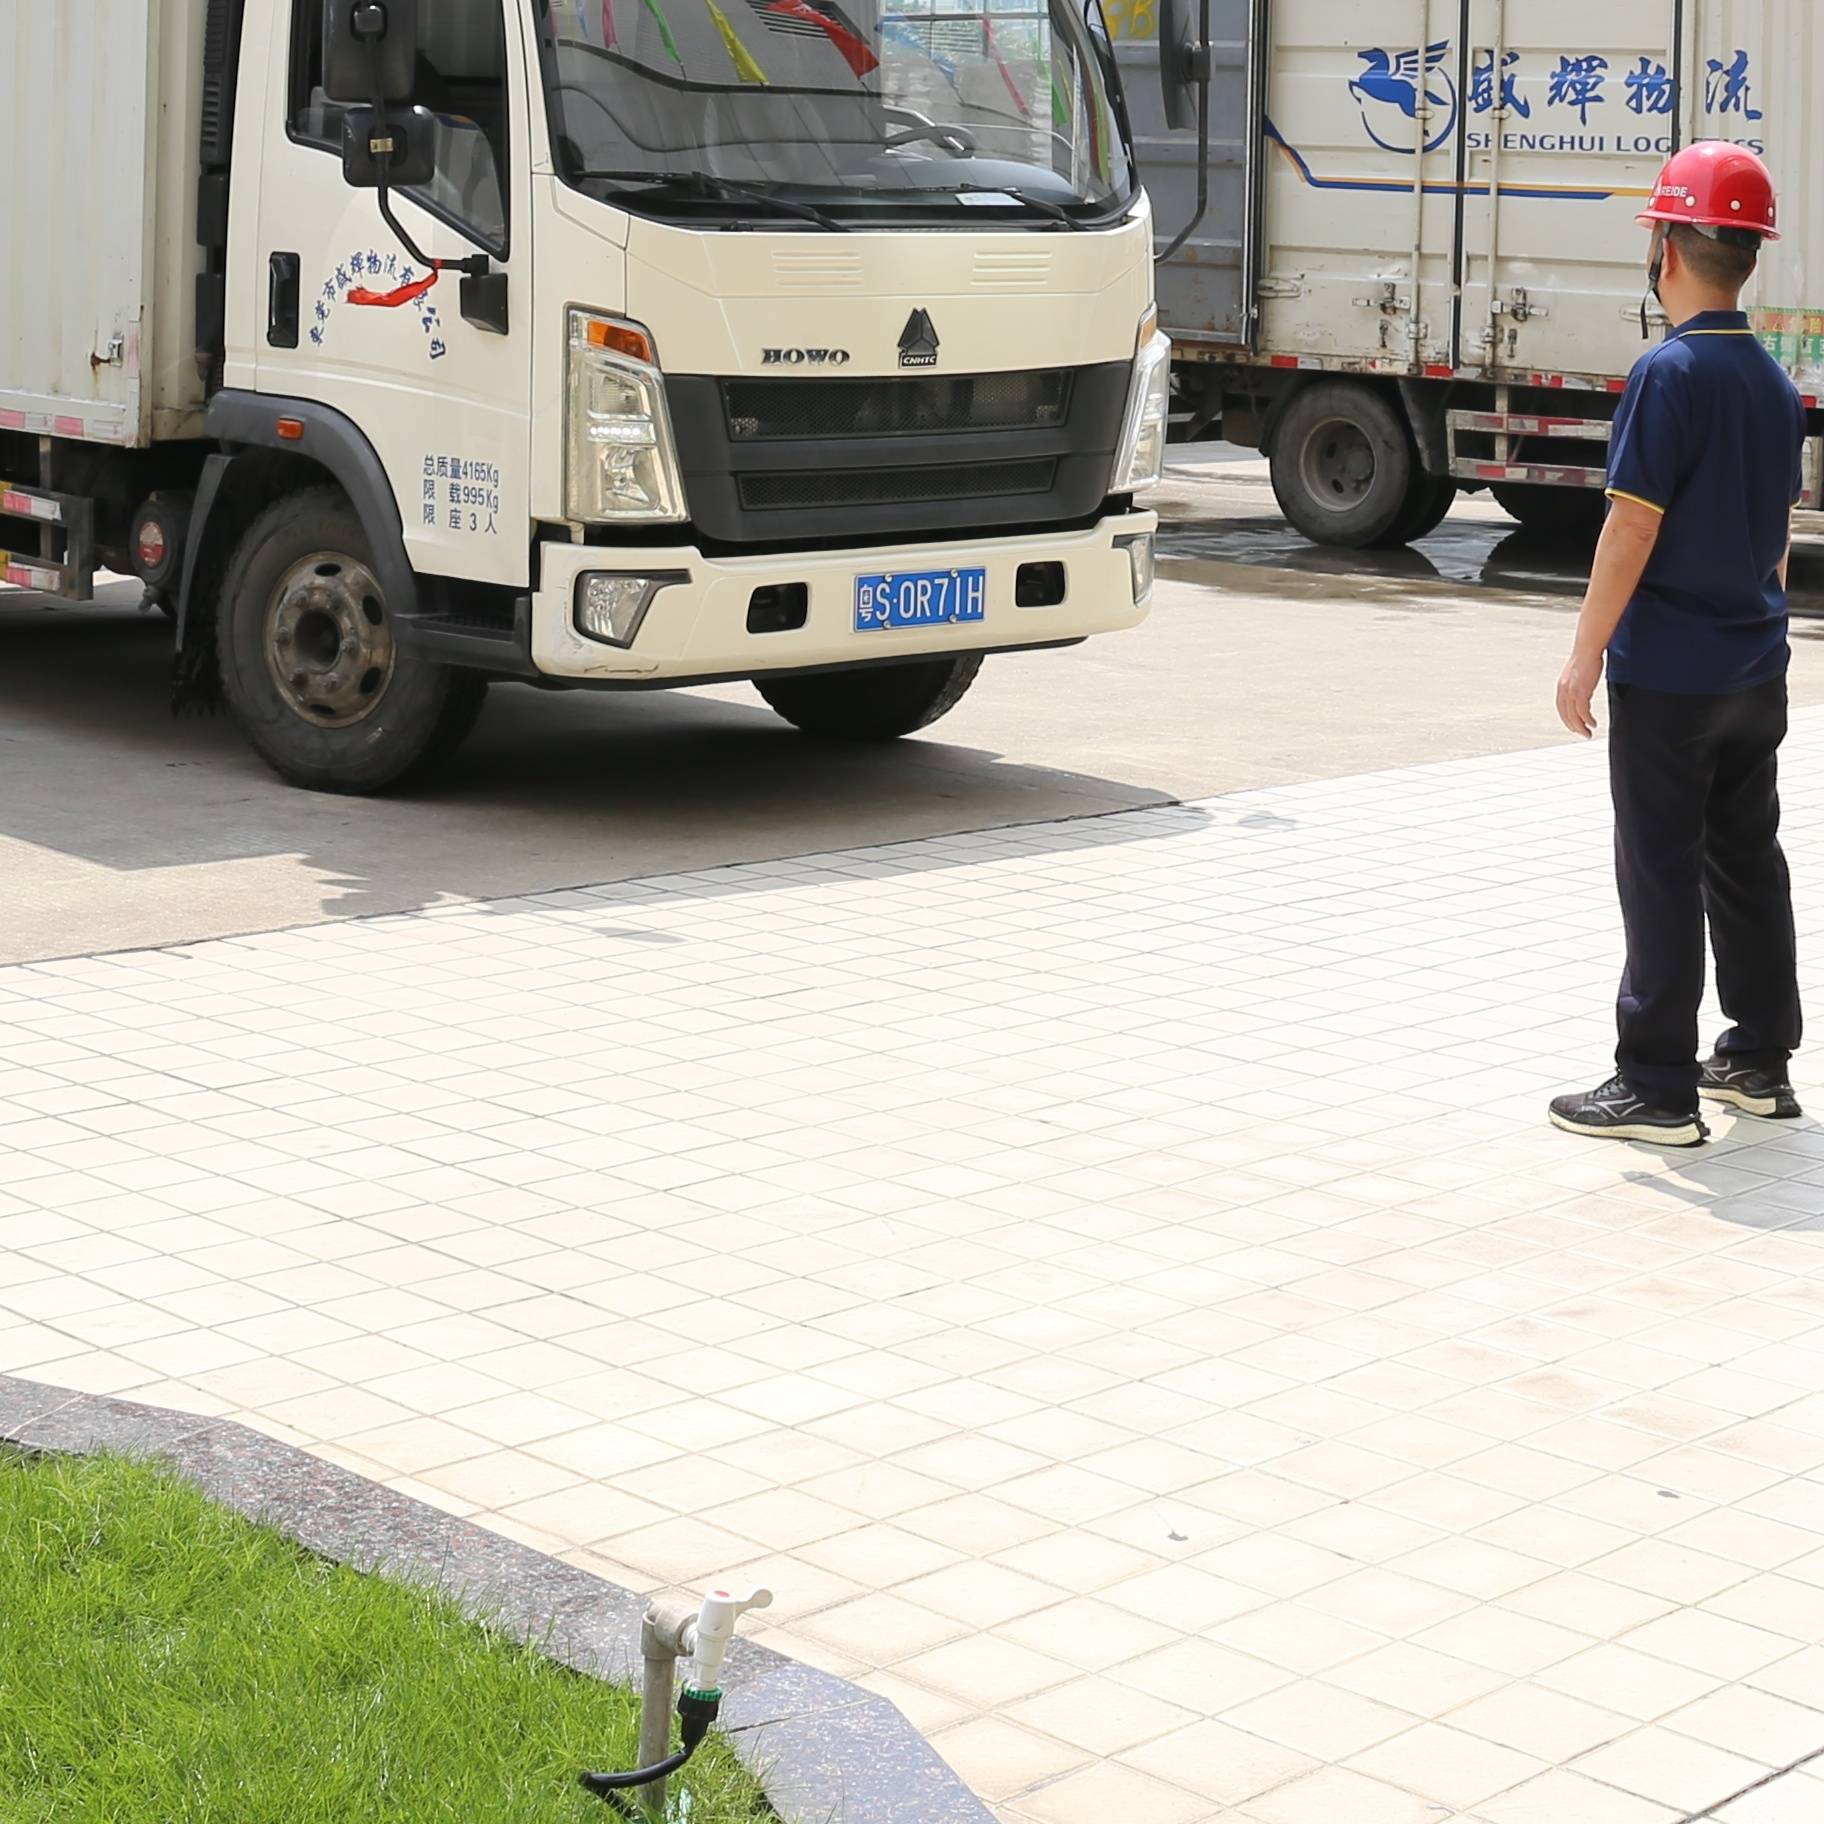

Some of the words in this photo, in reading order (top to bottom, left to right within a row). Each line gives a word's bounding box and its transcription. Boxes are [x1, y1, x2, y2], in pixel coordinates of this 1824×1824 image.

[1466, 133, 1605, 152] SHENGHUI
[761, 348, 851, 367] HOWO
[902, 354, 936, 366] CNHTC
